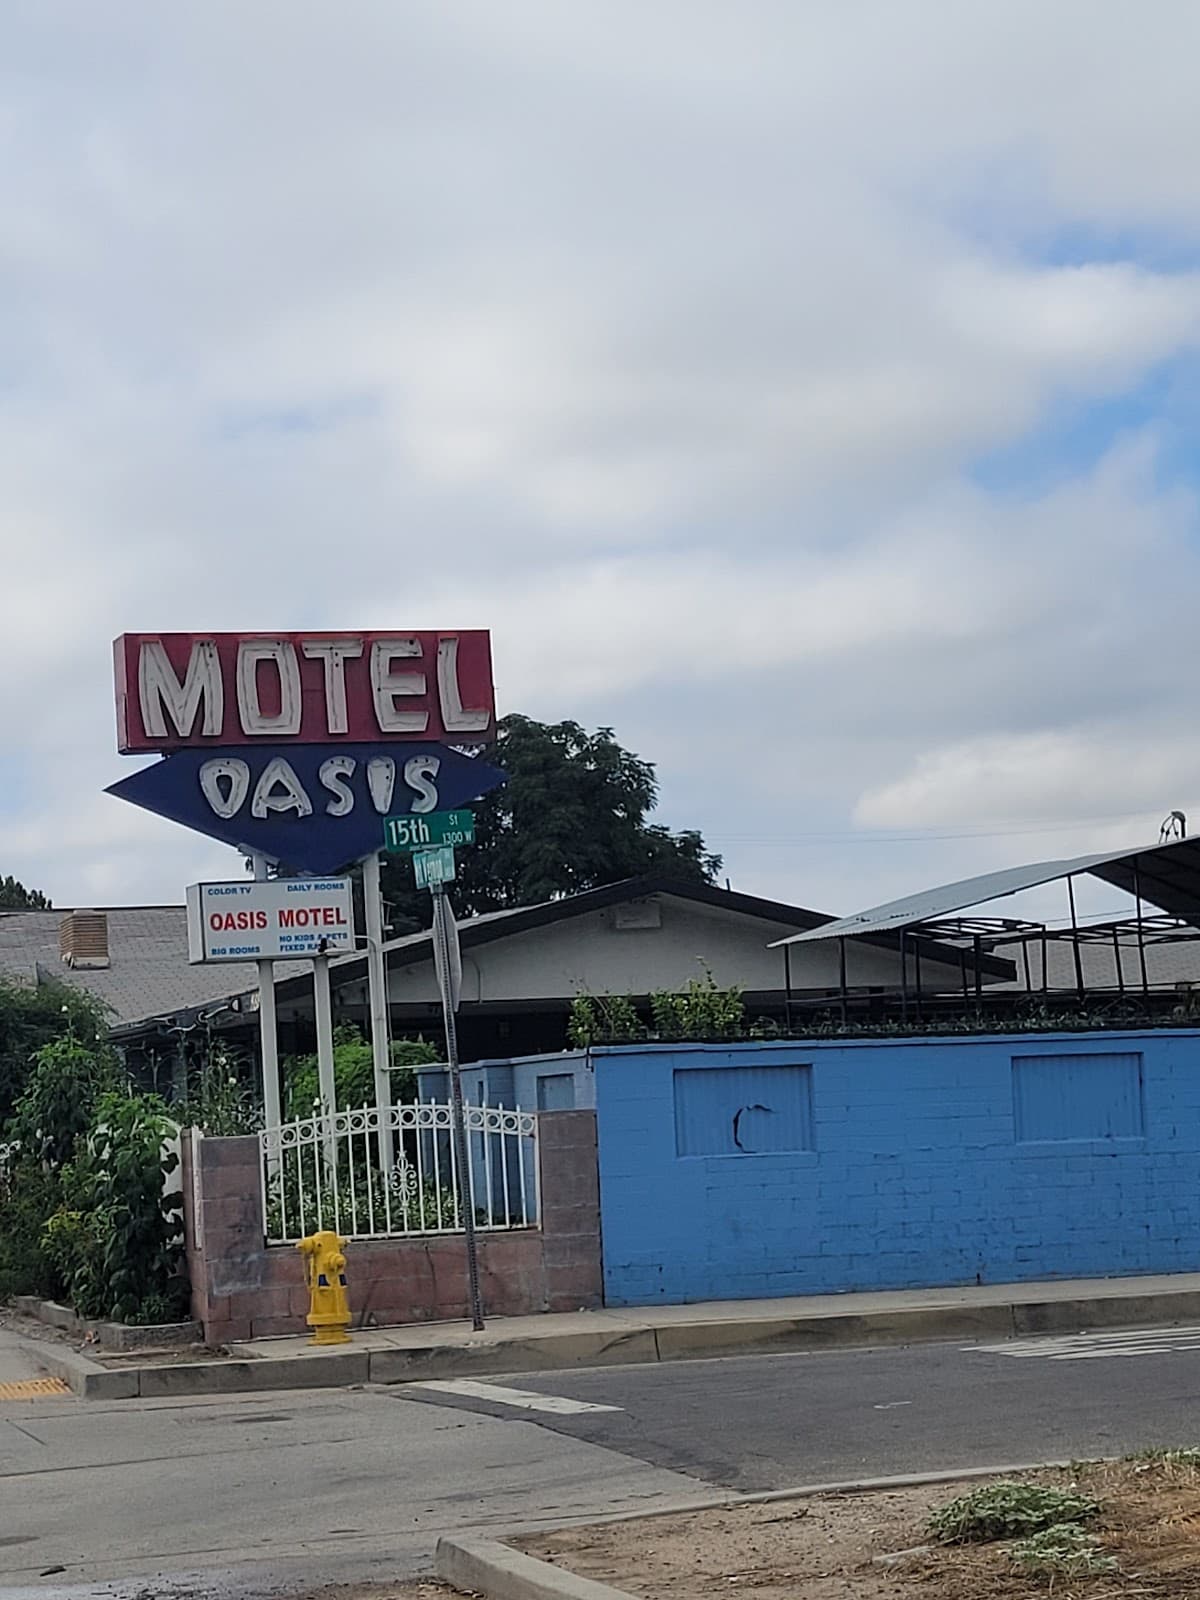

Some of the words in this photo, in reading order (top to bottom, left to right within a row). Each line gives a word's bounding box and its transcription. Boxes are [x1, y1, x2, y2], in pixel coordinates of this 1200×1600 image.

[138, 637, 490, 738] MOTEL
[199, 755, 441, 819] OASIS
[388, 818, 430, 846] 15th
[448, 814, 458, 826] St
[442, 831, 463, 845] 1300
[464, 830, 472, 841] W
[208, 887, 237, 896] COLOR
[239, 886, 252, 895] TV
[287, 884, 312, 892] DAILY
[314, 883, 345, 891] ROOMS
[210, 911, 268, 931] OASIS
[278, 907, 347, 928] MOTEL
[280, 935, 292, 943] NO
[295, 933, 315, 942] KIDS
[325, 932, 348, 940] PETS
[230, 946, 260, 954] ROOMS
[280, 944, 305, 952] FIXED
